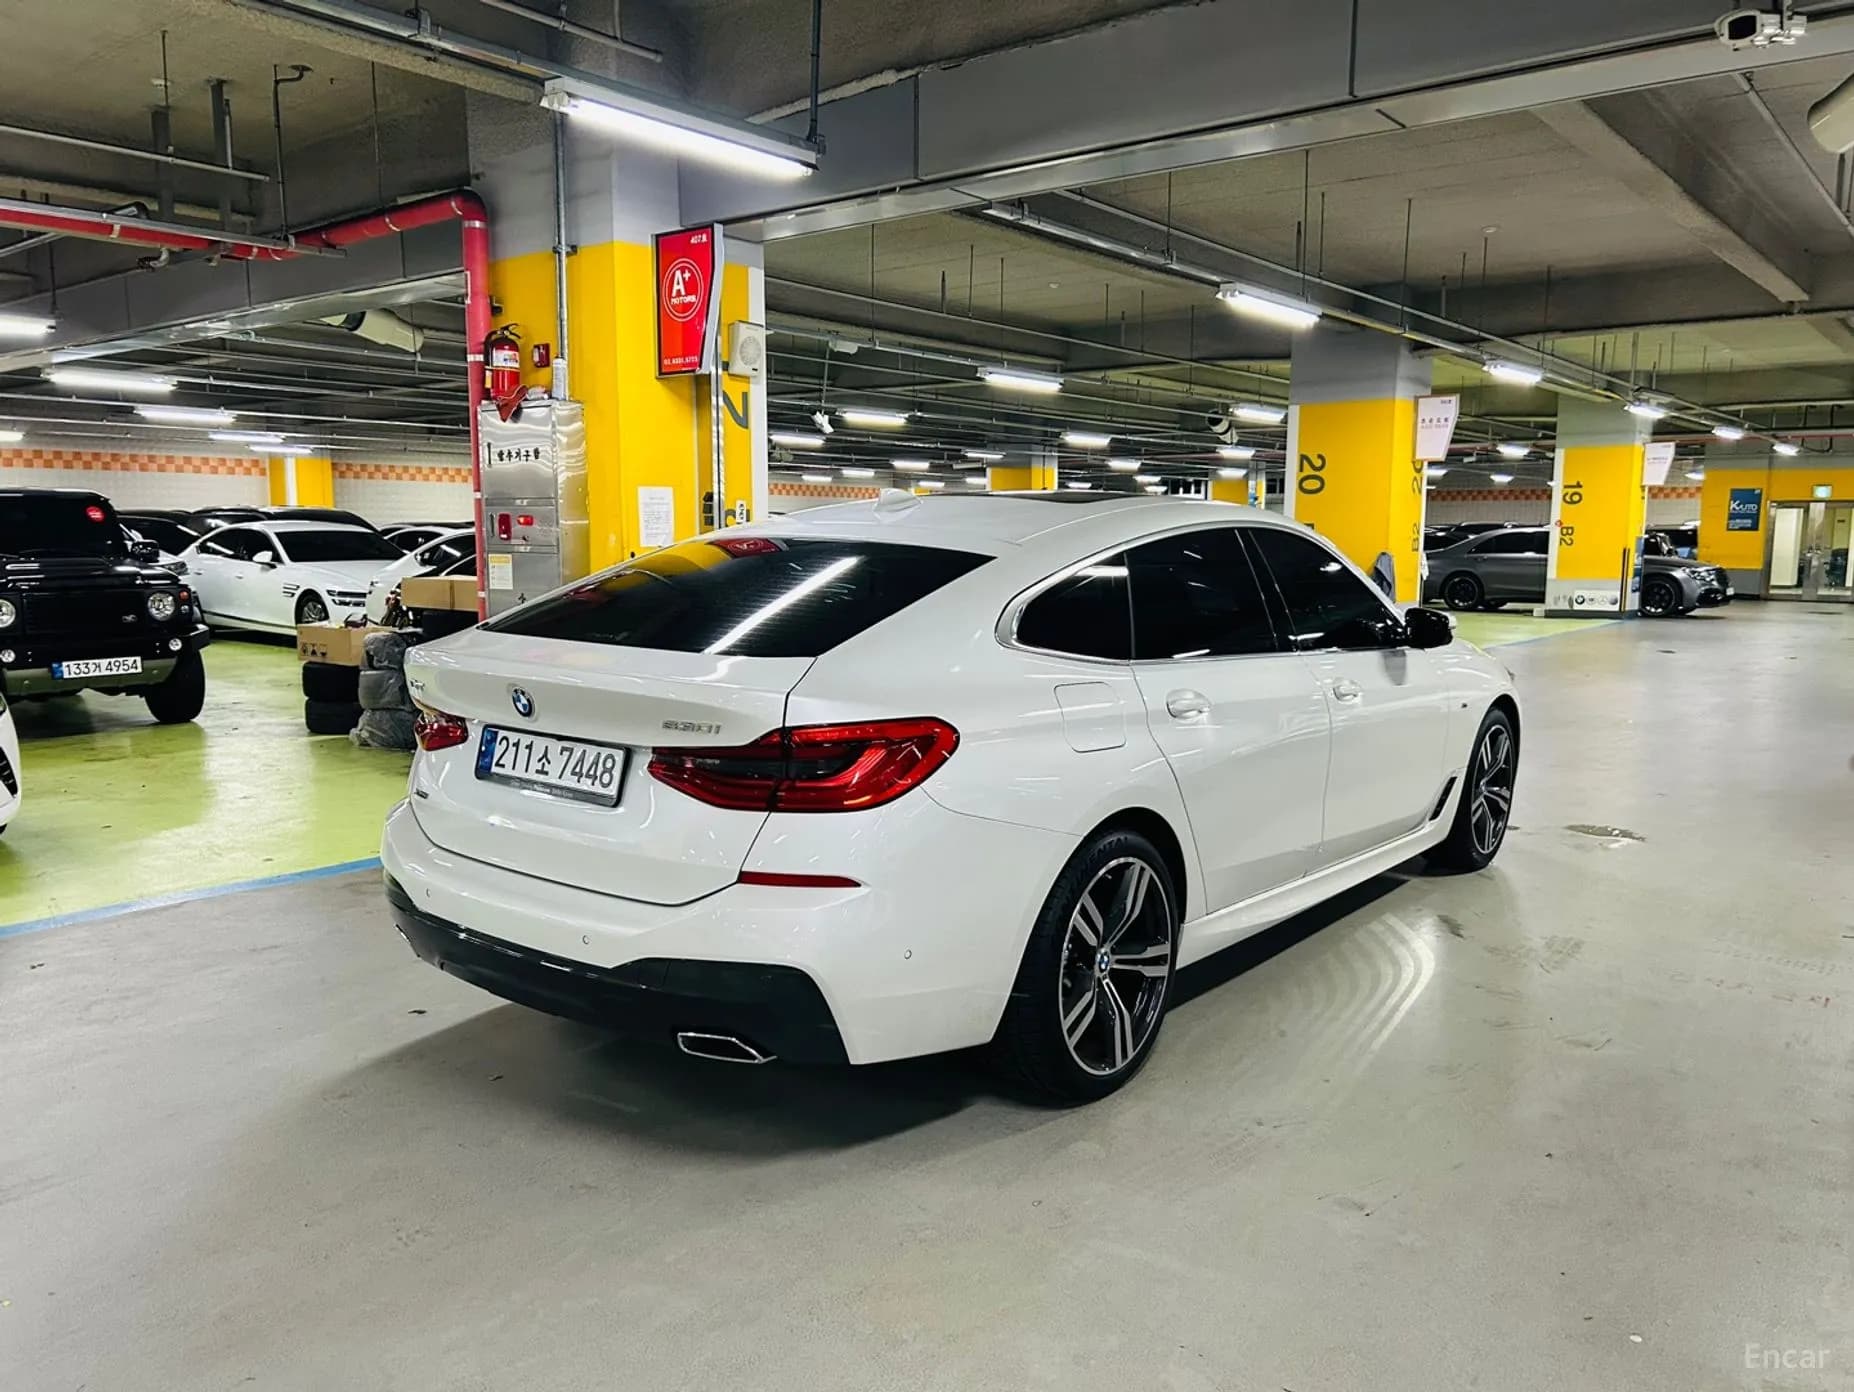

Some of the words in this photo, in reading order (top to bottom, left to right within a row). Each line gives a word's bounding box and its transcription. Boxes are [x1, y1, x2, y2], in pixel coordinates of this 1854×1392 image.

[671, 269, 691, 298] A+
[1298, 453, 1327, 495] 20
[1562, 480, 1583, 505] 19
[1559, 525, 1575, 547] B2
[105, 658, 138, 673] 4954
[494, 735, 552, 777] 211소
[558, 745, 617, 789] 7448
